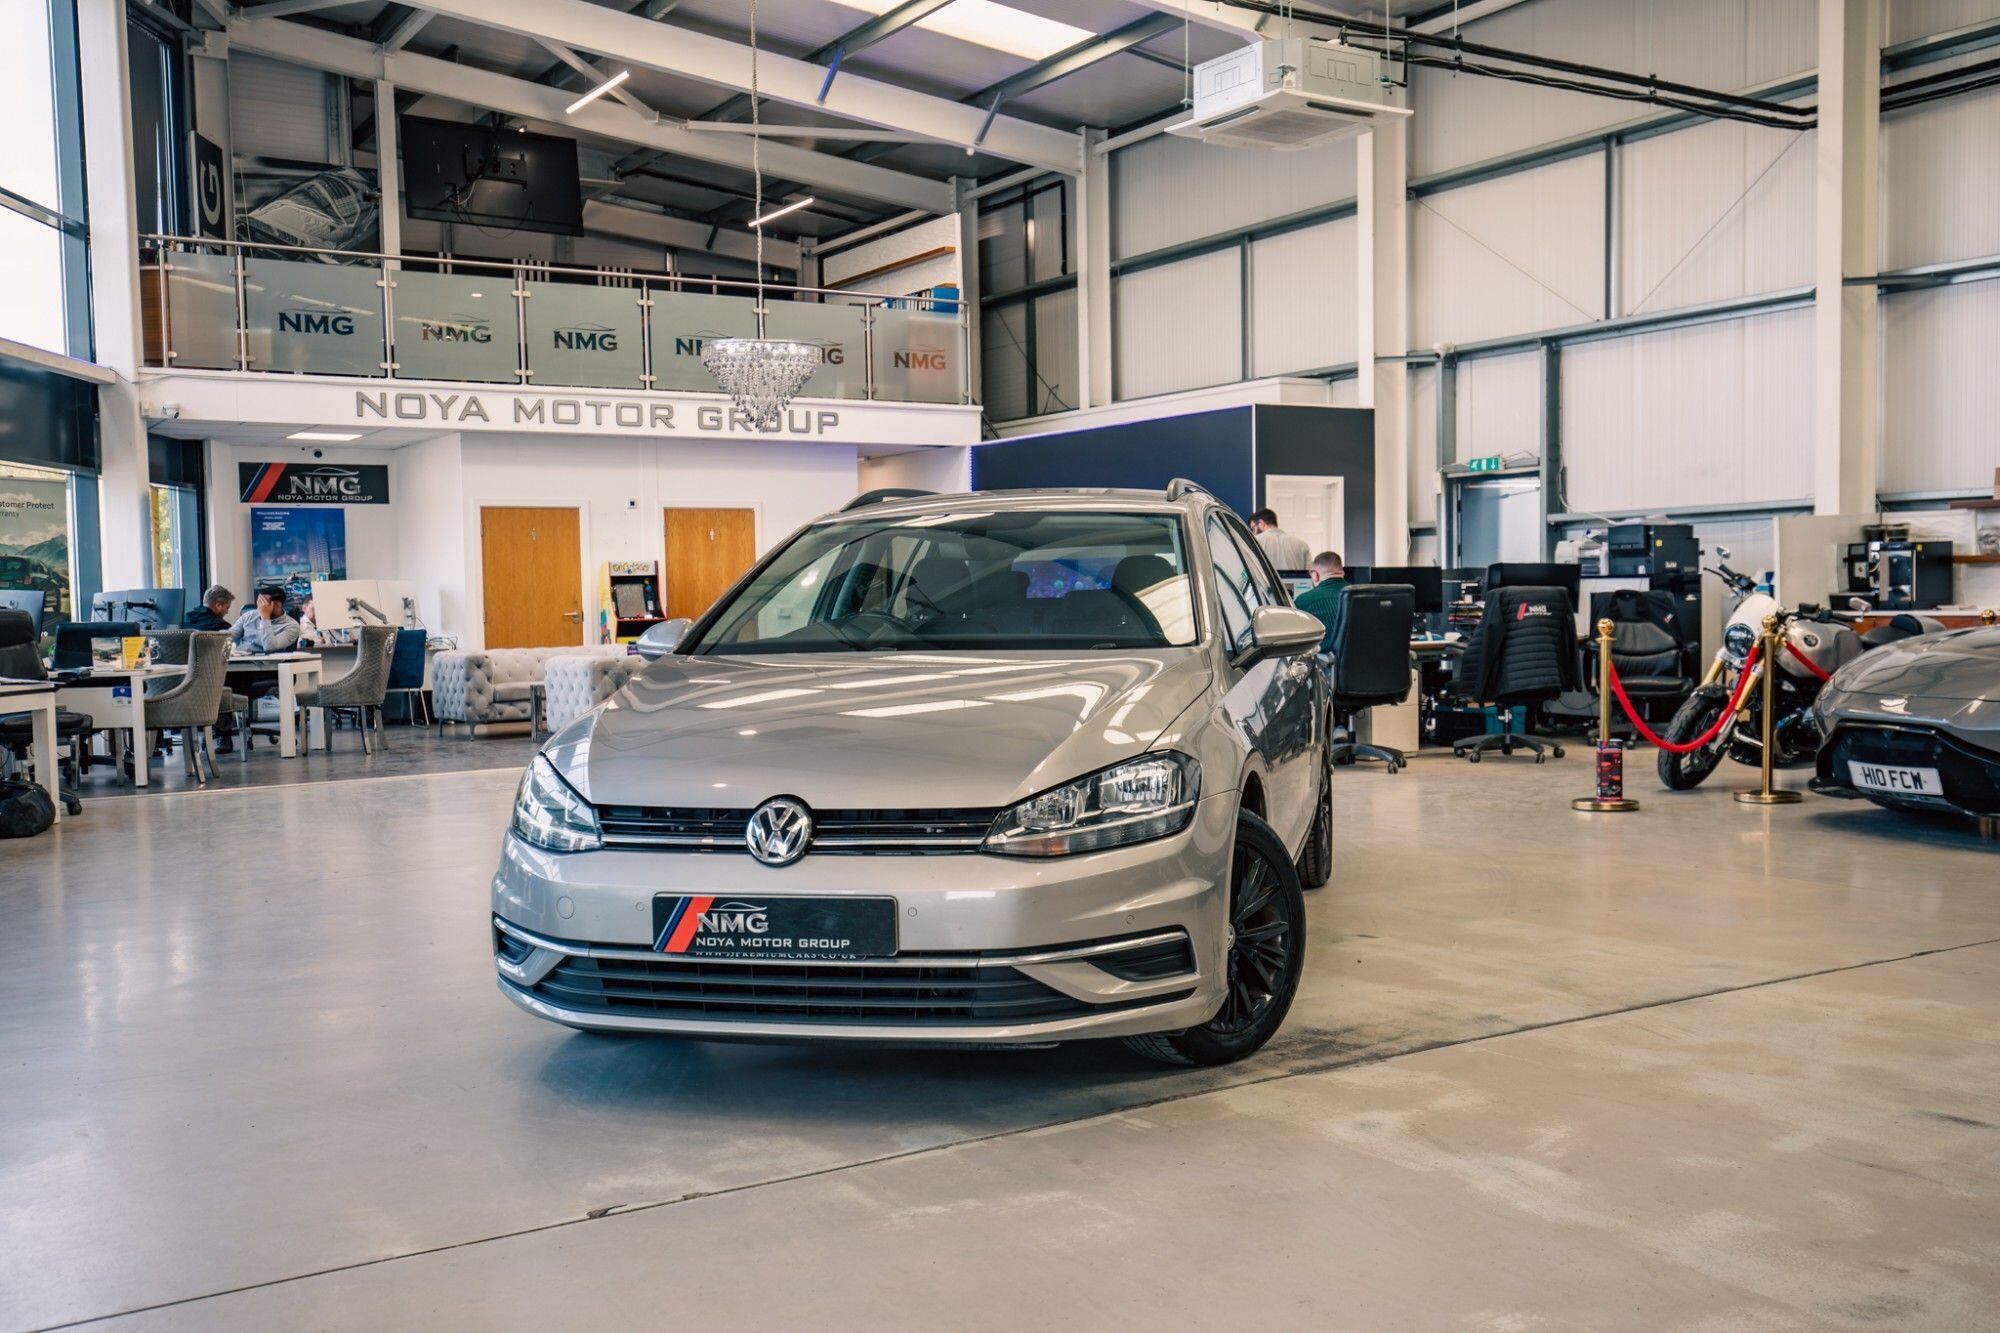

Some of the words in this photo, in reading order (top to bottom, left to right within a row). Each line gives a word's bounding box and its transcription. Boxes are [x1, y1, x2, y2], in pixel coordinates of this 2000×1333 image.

[279, 312, 354, 335] NMG
[422, 322, 492, 344] NMG
[553, 330, 618, 351] NMG
[893, 351, 946, 370] NMG
[356, 391, 490, 422] NOYA
[513, 397, 675, 429] MOTOR
[290, 475, 361, 495] NMG
[26, 501, 55, 510] Protect
[1862, 767, 1887, 786] H10
[1888, 770, 1923, 790] FCW
[696, 912, 769, 933] NMG
[696, 937, 735, 947] NOYA
[740, 938, 792, 948] MOTOR
[798, 938, 850, 949] GROUP
